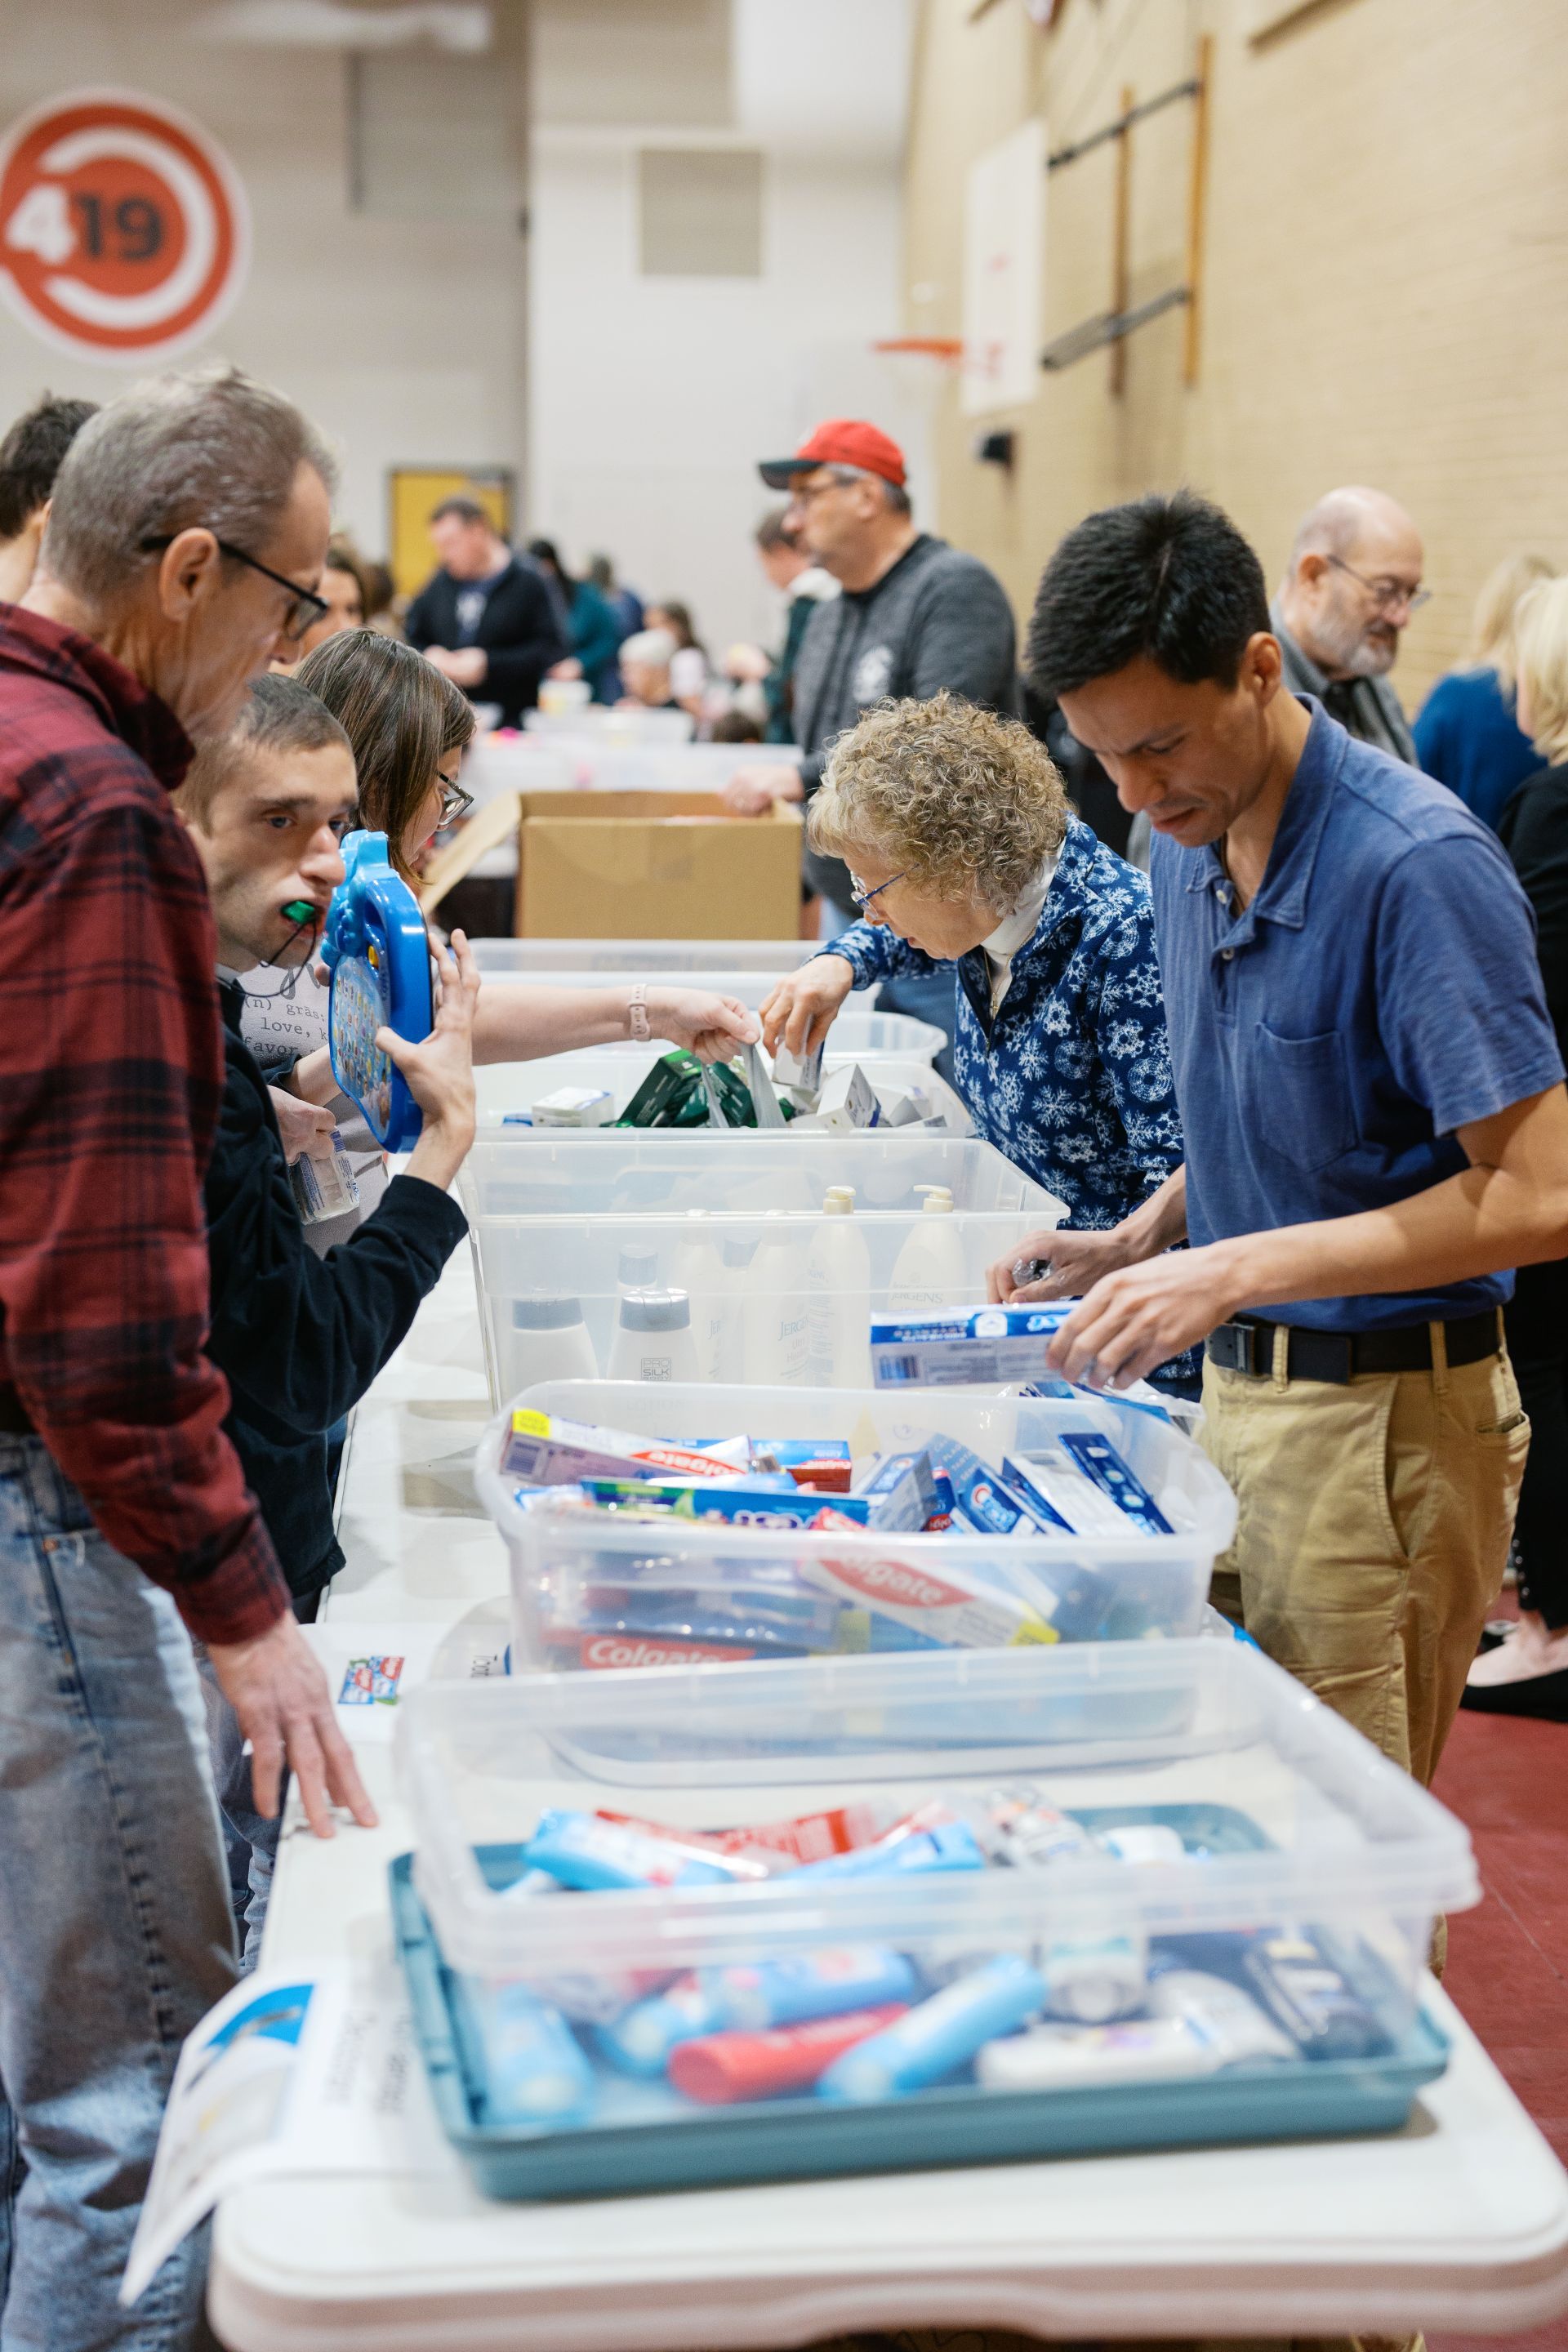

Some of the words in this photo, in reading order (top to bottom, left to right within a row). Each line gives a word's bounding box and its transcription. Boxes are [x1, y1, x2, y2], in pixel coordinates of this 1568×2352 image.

[6, 182, 164, 265] 419
[261, 1017, 310, 1038] love,
[643, 1359, 670, 1367] PRO
[838, 1554, 942, 1604] olgate
